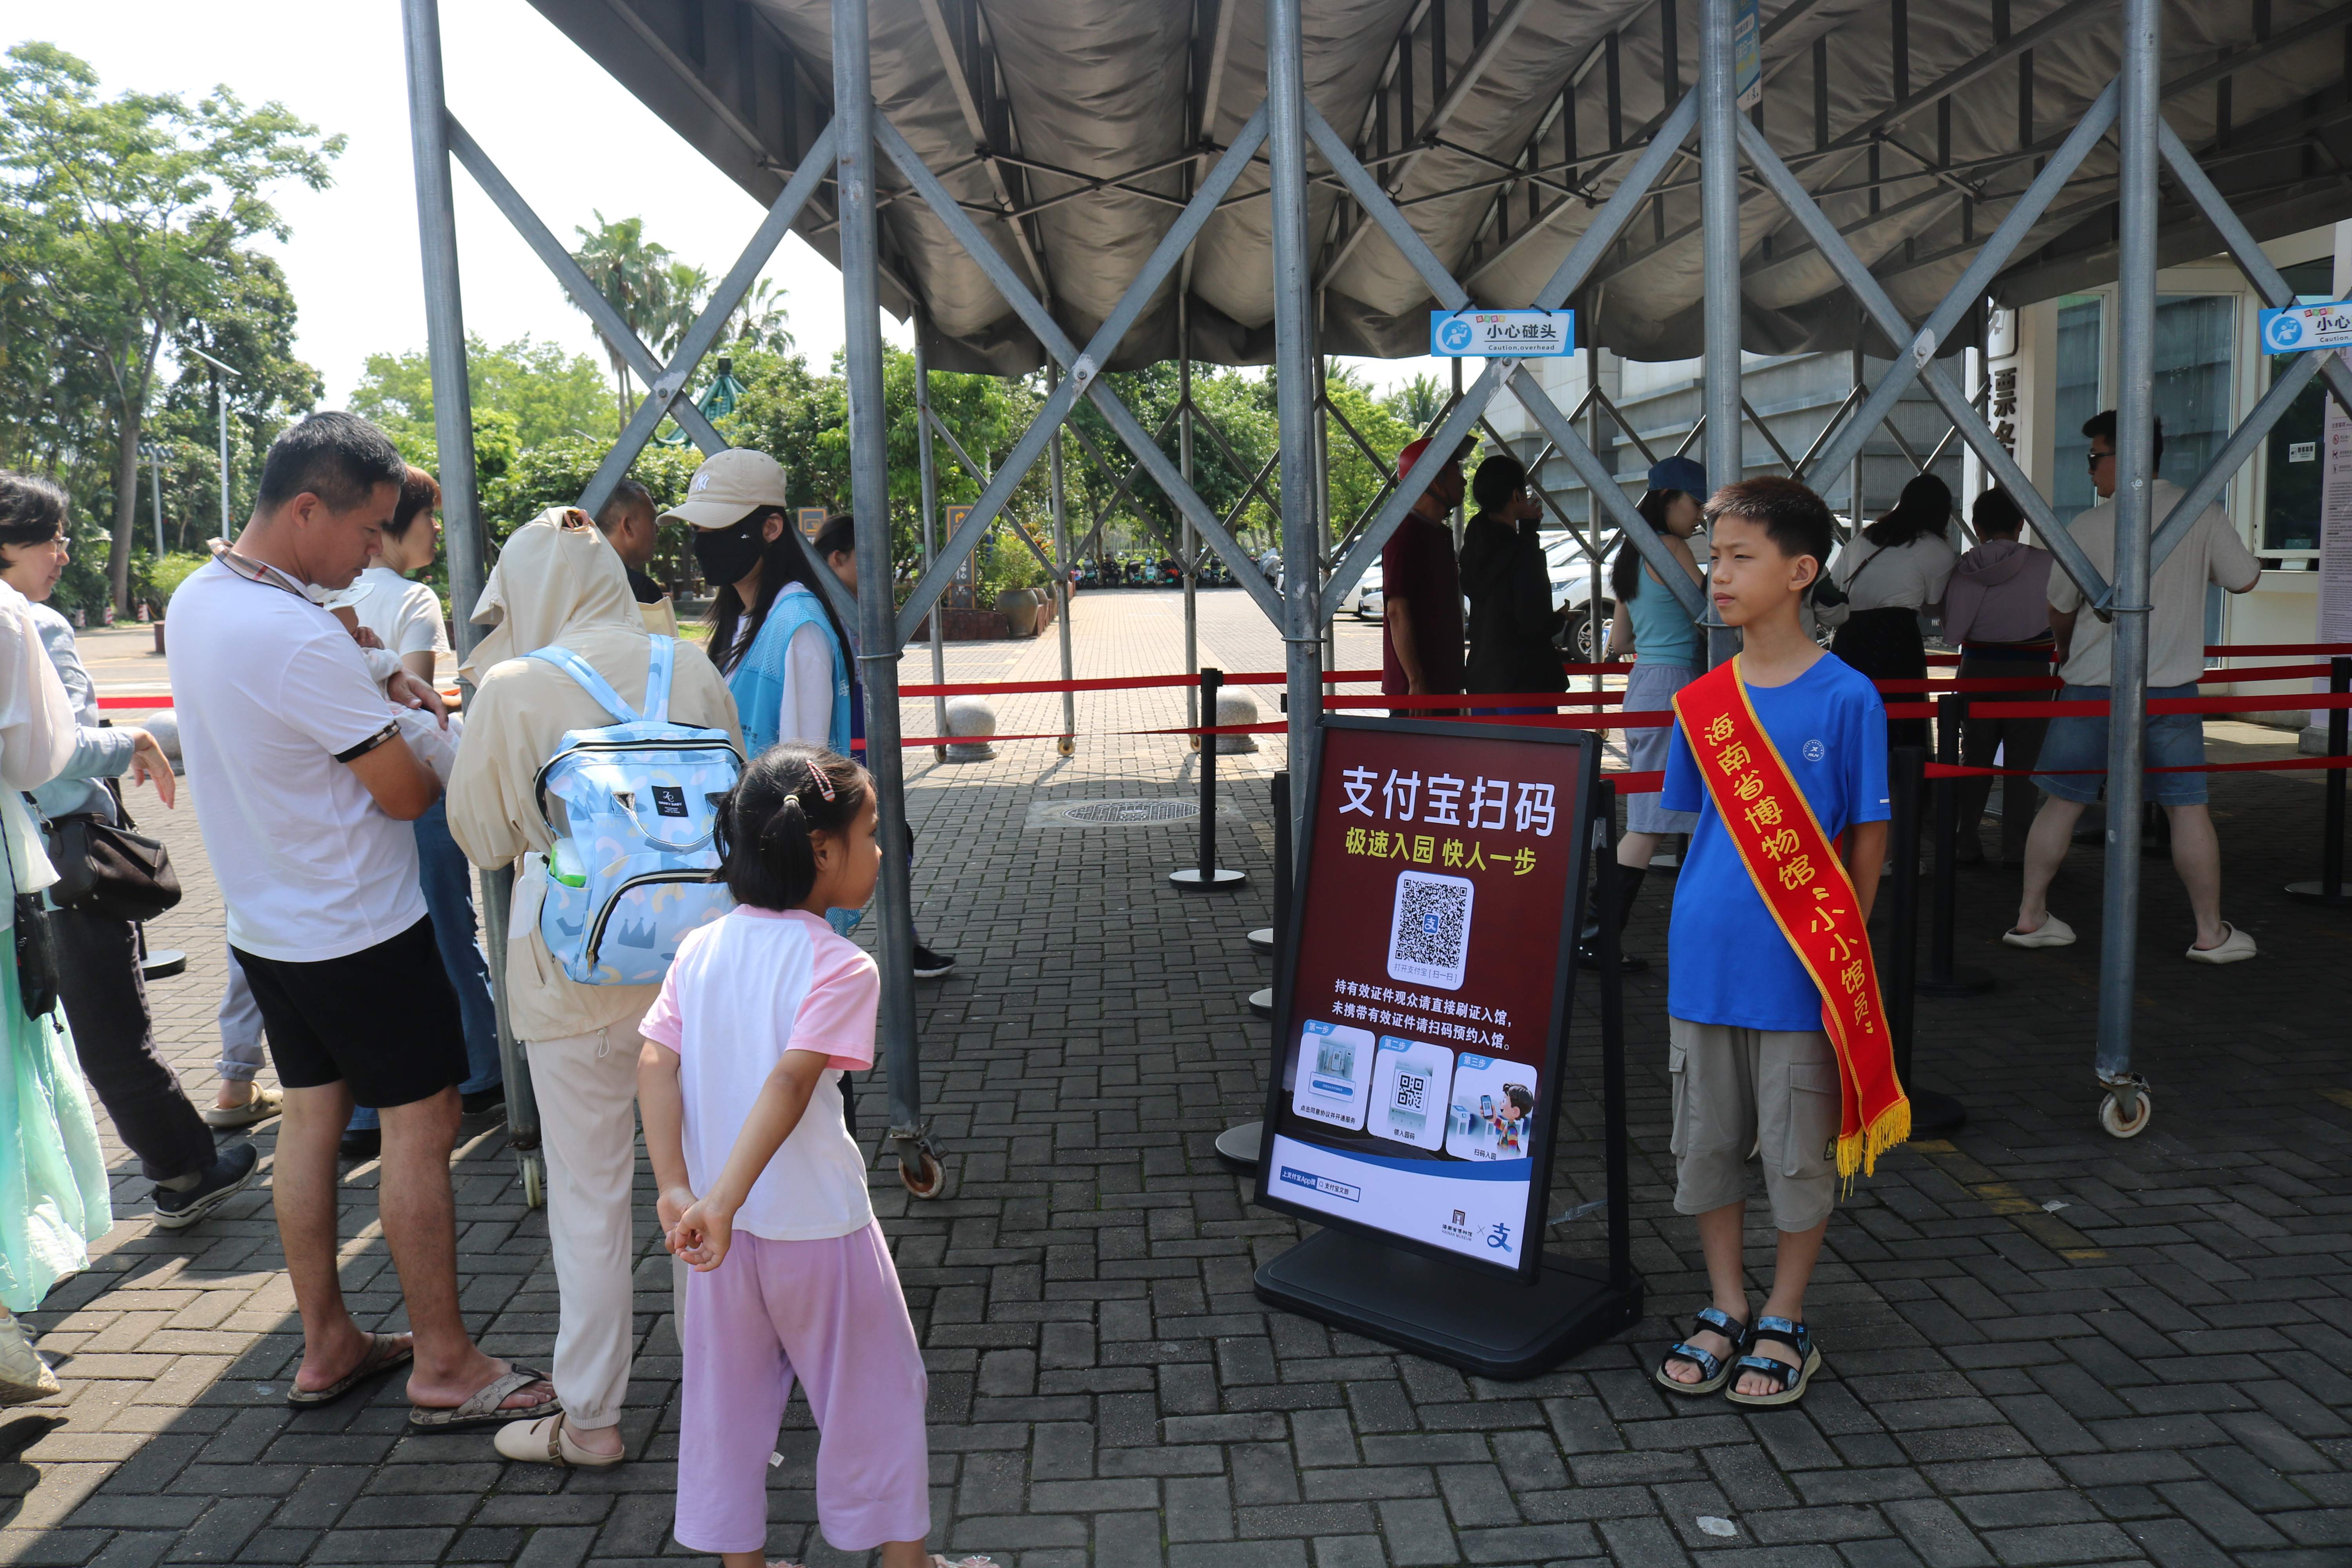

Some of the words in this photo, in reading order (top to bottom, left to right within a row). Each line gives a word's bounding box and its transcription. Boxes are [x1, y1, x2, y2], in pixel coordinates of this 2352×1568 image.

[2317, 315, 2352, 331] 小心
[1486, 324, 1557, 338] 小心碰头
[1338, 765, 1556, 837] 支付宝扫码
[1345, 826, 1435, 864] 极速入园
[1442, 837, 1537, 876] 快人一步
[1308, 1022, 1329, 1034] 第一步
[1332, 1001, 1510, 1051] 未携带有效证件请扫码预约入馆。
[1384, 1038, 1406, 1050] 第二步
[1463, 1055, 1486, 1068] 第三步
[1300, 1105, 1356, 1124] 点击同意协议并开通服务
[1394, 1128, 1415, 1140] 领入园码
[1474, 1148, 1497, 1160] 扫码入园
[1282, 1170, 1316, 1186] 上支付宝App搜
[1324, 1183, 1349, 1195] 支付宝文旅
[1442, 1223, 1473, 1237] 海南省博物馆
